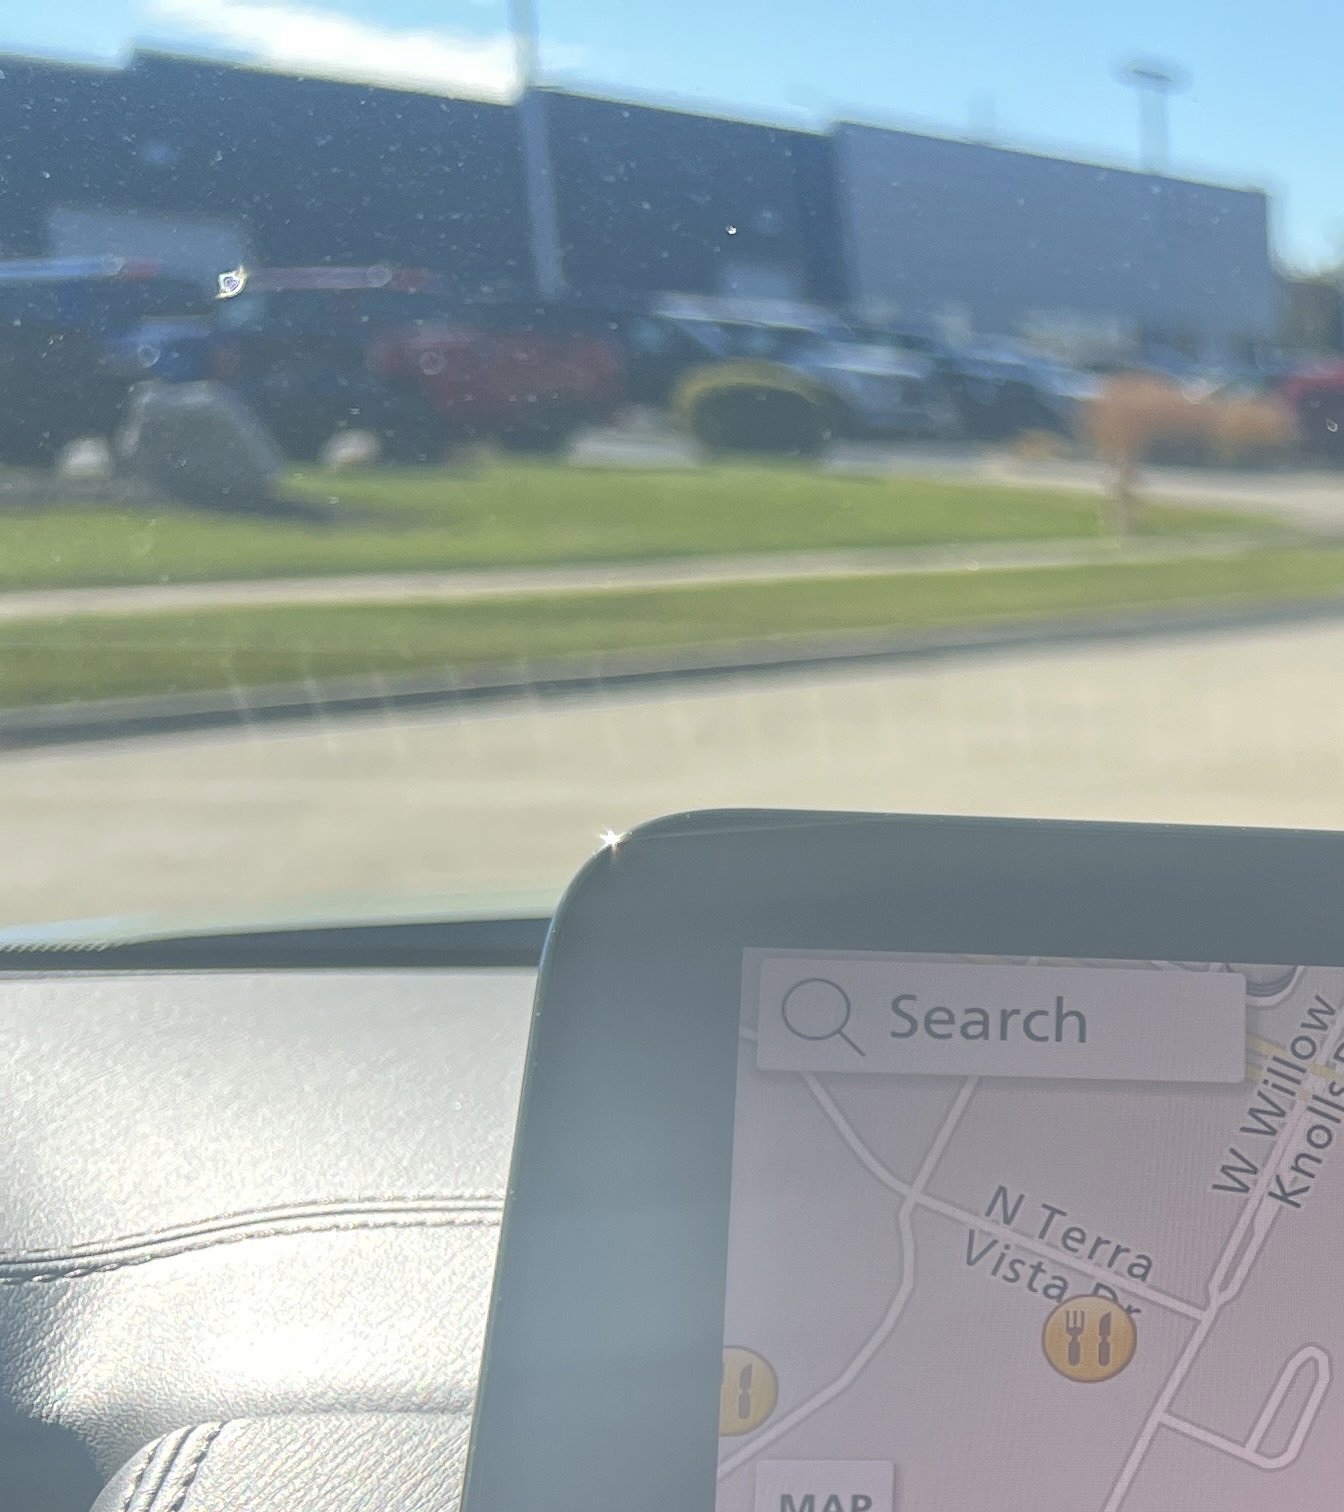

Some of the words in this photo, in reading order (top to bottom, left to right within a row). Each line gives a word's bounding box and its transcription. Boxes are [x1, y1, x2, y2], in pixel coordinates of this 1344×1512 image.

[889, 992, 1089, 1044] Search
[1211, 1147, 1260, 1196] W
[1239, 994, 1337, 1139] Willow
[963, 1229, 1070, 1305] Vista
[983, 1184, 1025, 1226] N
[1037, 1204, 1156, 1283] Terra
